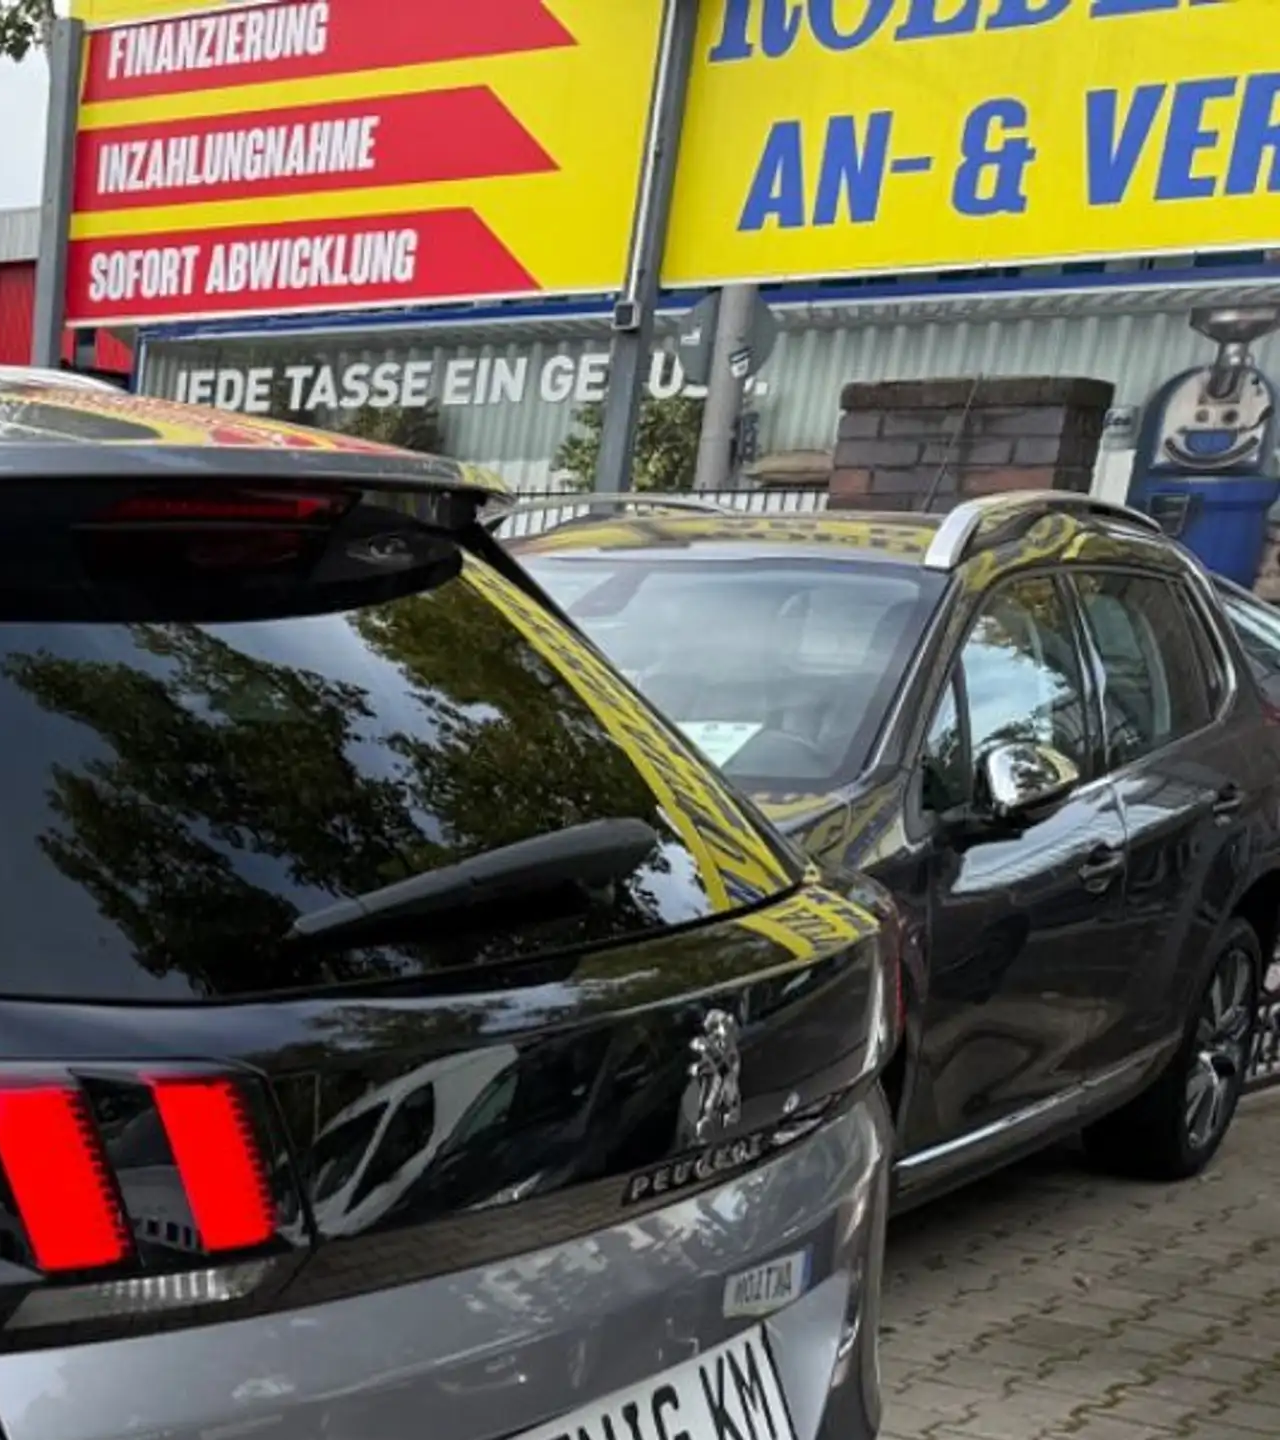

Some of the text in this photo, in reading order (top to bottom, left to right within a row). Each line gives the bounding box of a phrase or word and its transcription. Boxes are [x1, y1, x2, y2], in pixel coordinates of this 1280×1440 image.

[108, 2, 328, 79] FINANZIERUNG
[96, 116, 380, 194] INZAHLUNGNAHME
[737, 110, 933, 232] AN-
[951, 98, 1037, 217] &
[88, 229, 419, 302] SOFORT ABWICKLUNG
[284, 362, 433, 411] TASSE
[443, 356, 527, 406] EIN
